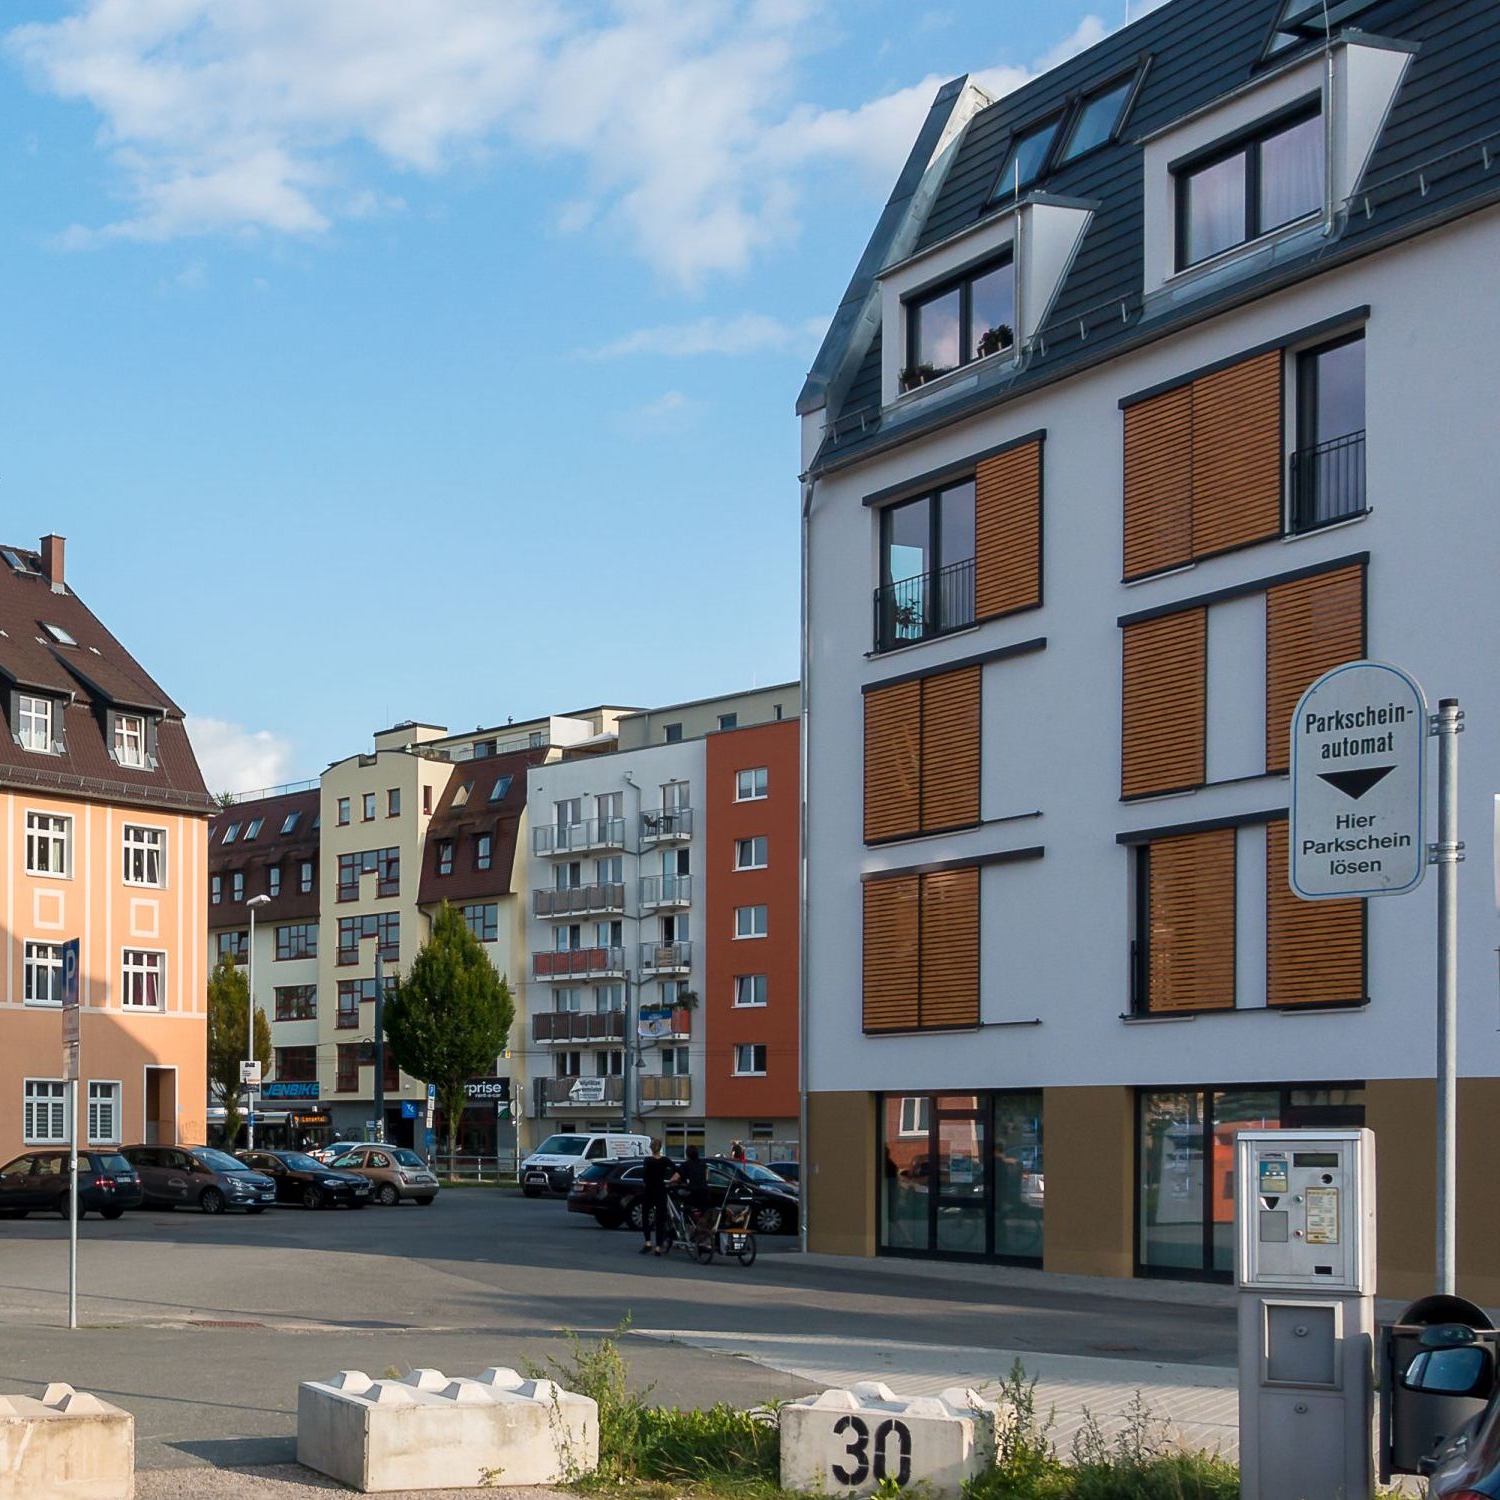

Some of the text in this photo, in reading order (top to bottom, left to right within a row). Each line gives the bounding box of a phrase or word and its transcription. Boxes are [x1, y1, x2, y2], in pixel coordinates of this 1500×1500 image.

[1306, 703, 1413, 734] Parkschein-
[1321, 732, 1393, 759] automat
[1336, 814, 1375, 830] Hier
[1303, 833, 1411, 855] Parkschein
[1330, 860, 1381, 876] lösen
[66, 949, 76, 997] P
[262, 1083, 319, 1096] JENBIKE
[463, 1081, 501, 1096] rprise
[832, 1416, 911, 1486] 30
